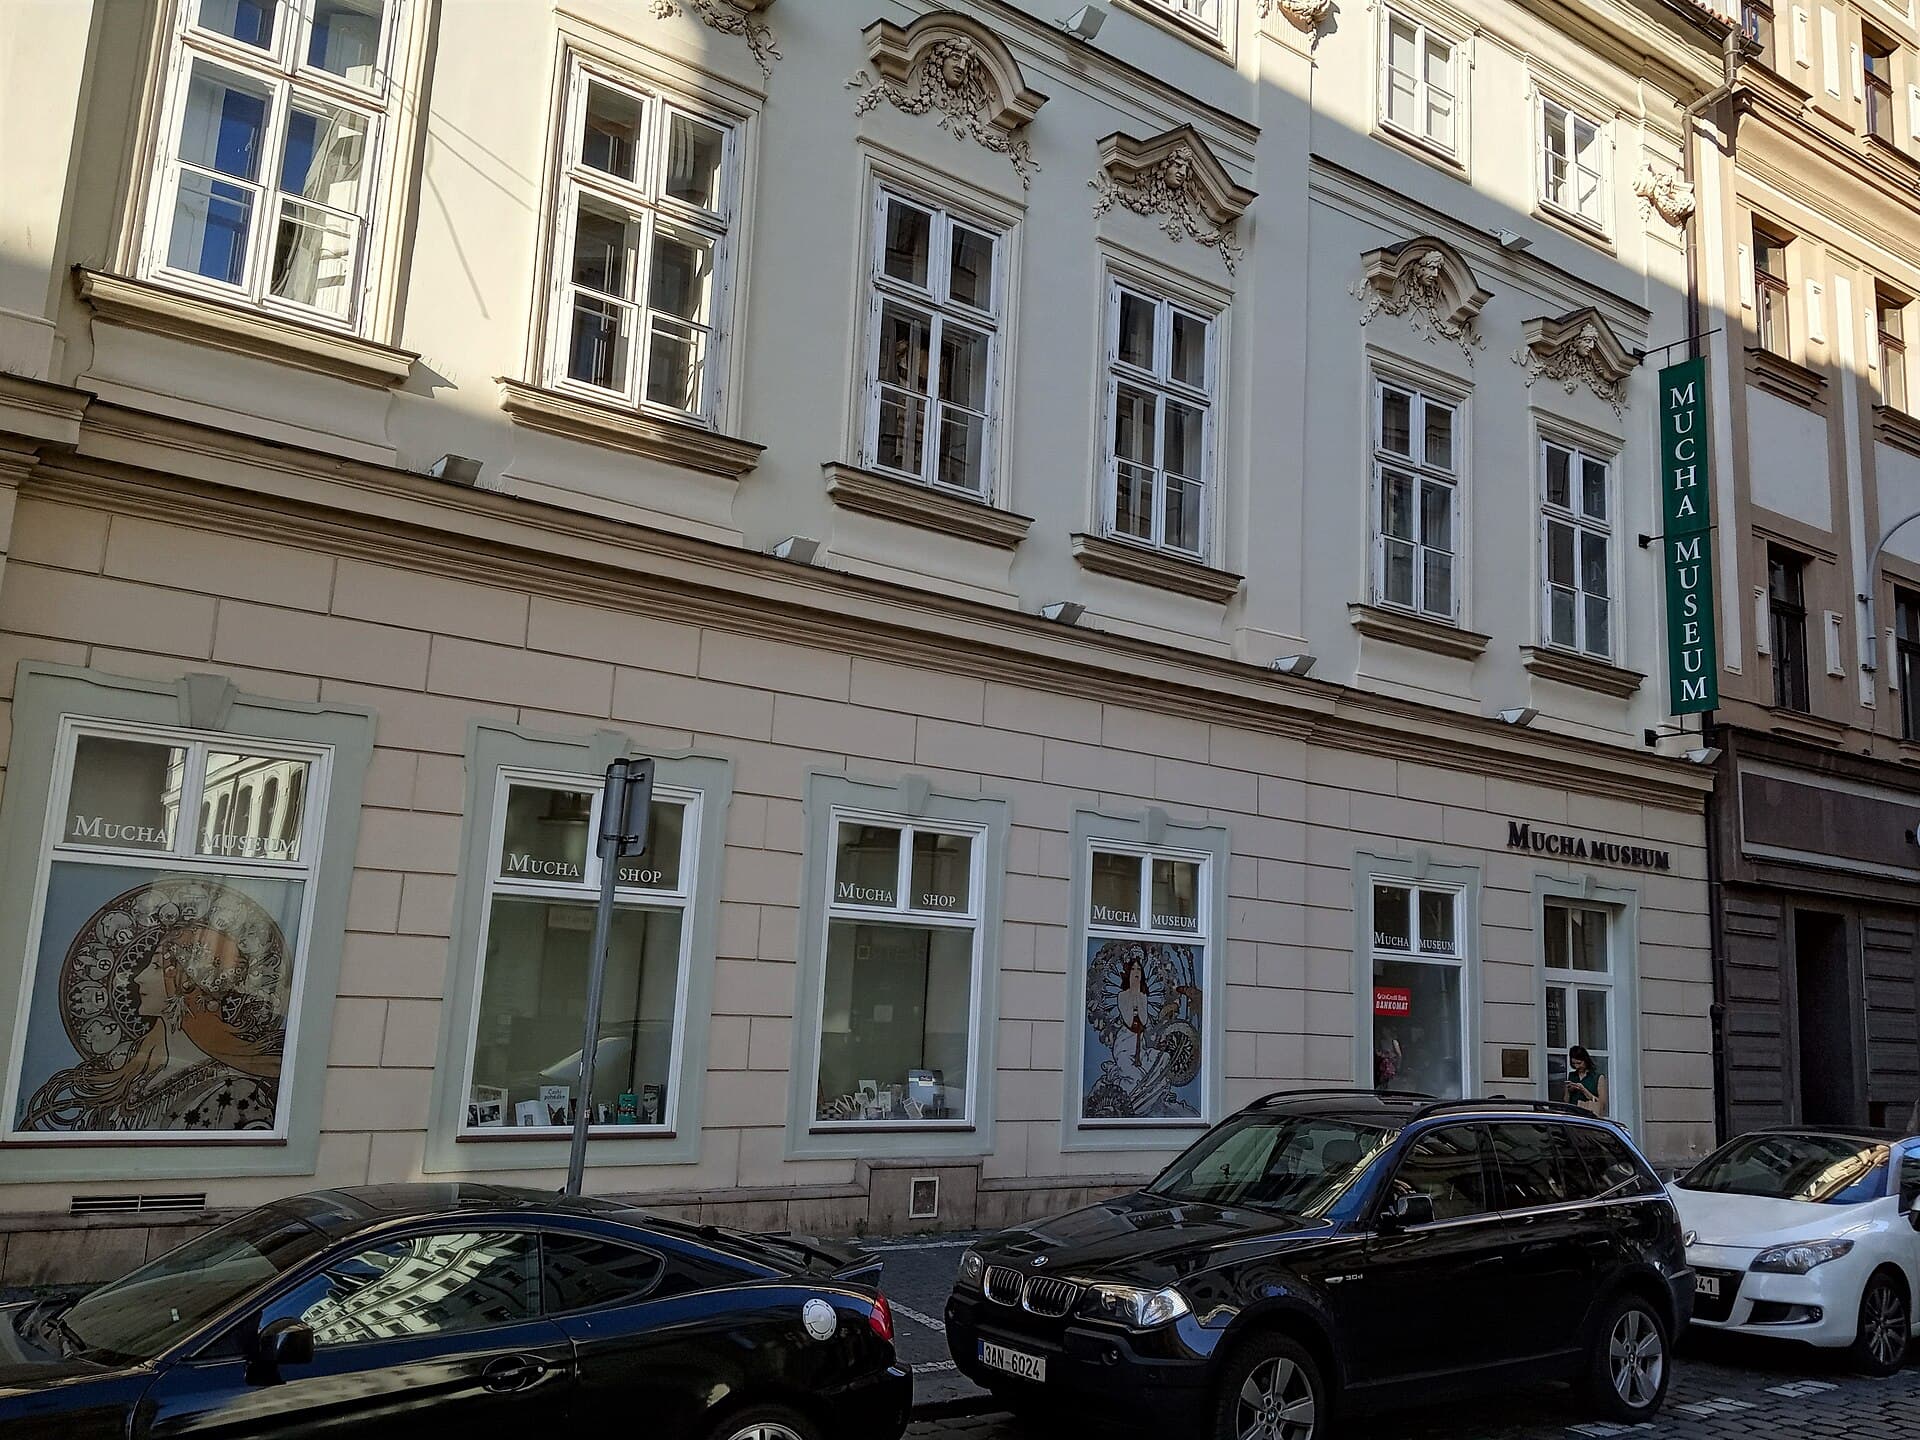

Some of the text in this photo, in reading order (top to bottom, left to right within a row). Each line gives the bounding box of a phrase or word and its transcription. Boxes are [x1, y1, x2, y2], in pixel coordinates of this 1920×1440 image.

[1670, 380, 1708, 702] MUCHA MUSEUM
[71, 815, 297, 854] MUCHA MUSEUM
[1506, 820, 1671, 870] MUCHA MUSEUM
[507, 853, 662, 883] MUCHA SHOP
[838, 881, 956, 907] MUCHA SHOP
[1093, 904, 1197, 928] MUCHA MUSEUM
[1374, 931, 1455, 951] MUCHA MUSEUM
[1375, 1000, 1408, 1011] BANKOMAT
